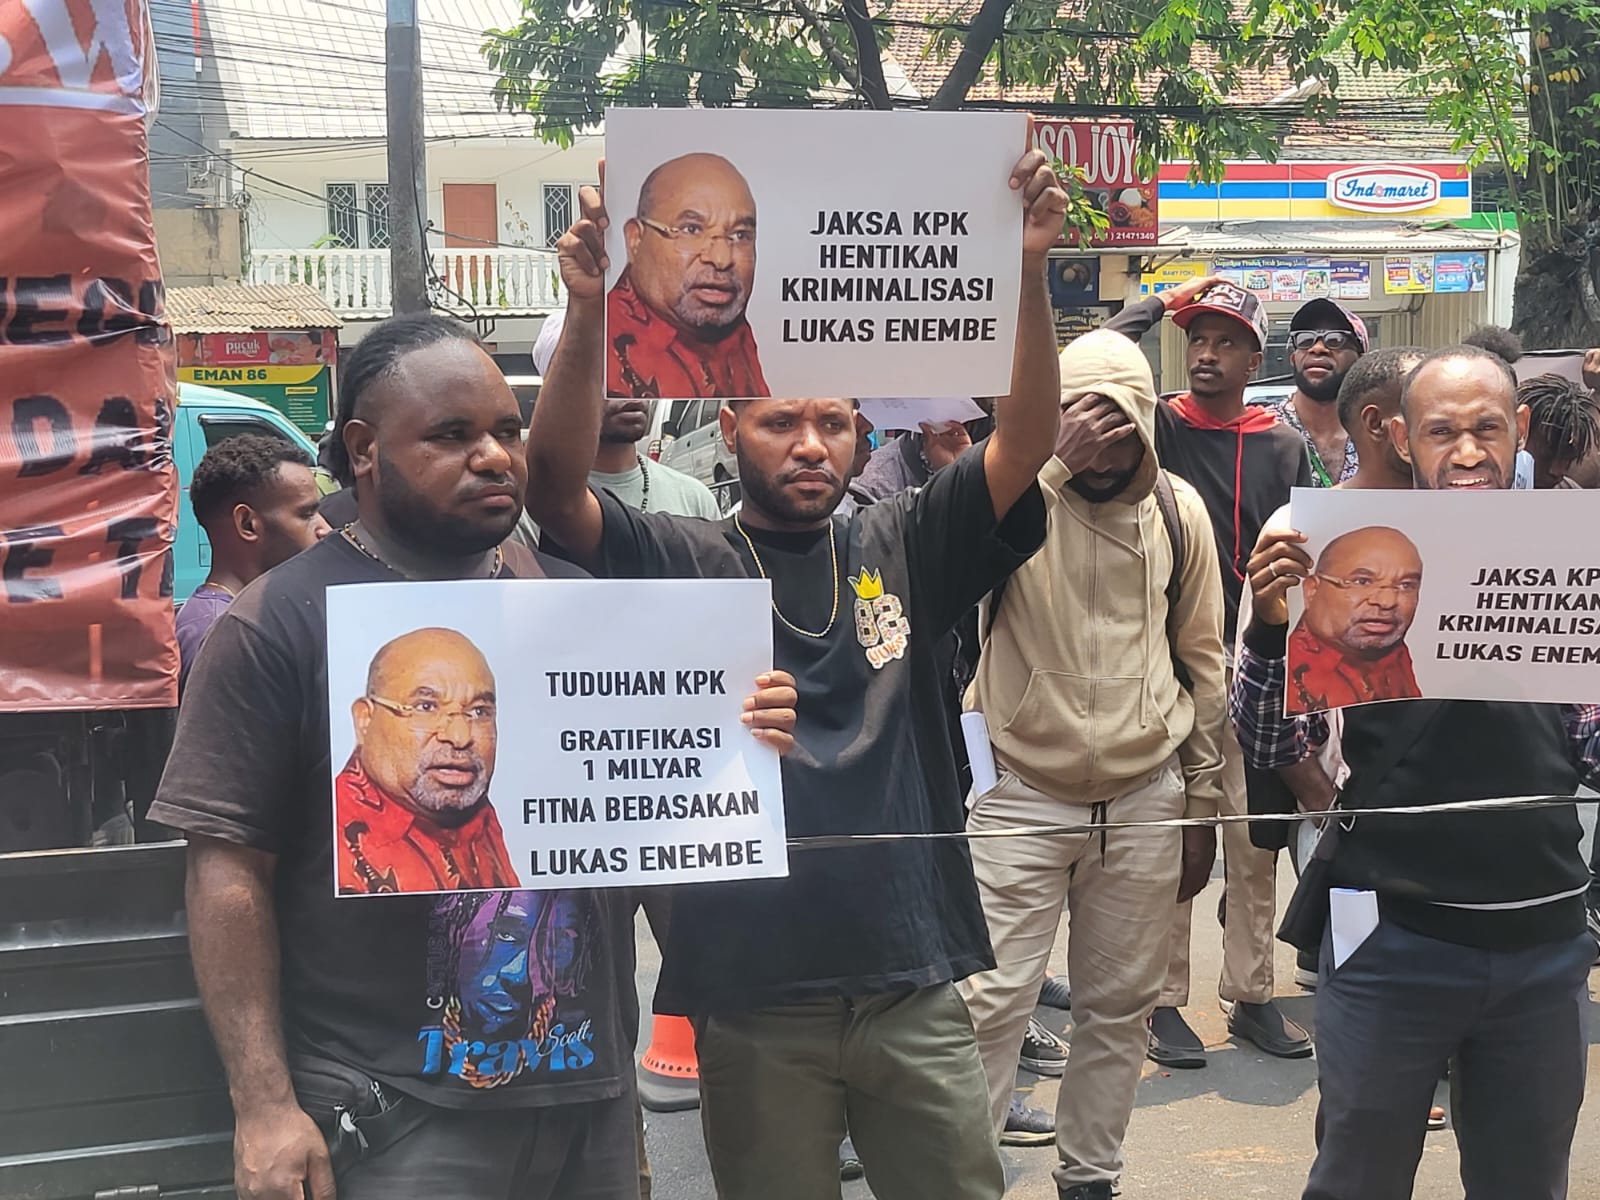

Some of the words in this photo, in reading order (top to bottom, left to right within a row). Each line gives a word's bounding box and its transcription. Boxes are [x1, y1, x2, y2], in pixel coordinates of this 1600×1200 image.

[1033, 124, 1077, 183] SO
[1342, 179, 1429, 197] Indomaret
[810, 211, 902, 235] JAKSA
[913, 211, 969, 235] KPK
[820, 244, 958, 268] HENTIKAN
[782, 278, 993, 301] KRIMINALISASI
[783, 319, 875, 342] LUKAS
[885, 318, 997, 341] ENEMBE
[194, 370, 242, 380] EMAN
[247, 370, 267, 380] 86
[1470, 568, 1556, 586] JAKSA
[1436, 643, 1522, 661] LUKAS
[545, 671, 666, 697] TUDUHAN
[676, 670, 726, 695] KPK
[560, 728, 721, 751] GRATIFIKASI
[583, 759, 594, 780] 1
[608, 757, 702, 780] MILYAR
[523, 797, 597, 824] FITNA
[605, 790, 759, 821] BEBASAKAN
[531, 847, 629, 876] LUKAS
[639, 840, 763, 871] ENEMBE
[536, 1018, 592, 1057] Scott
[417, 1026, 595, 1076] Travis
